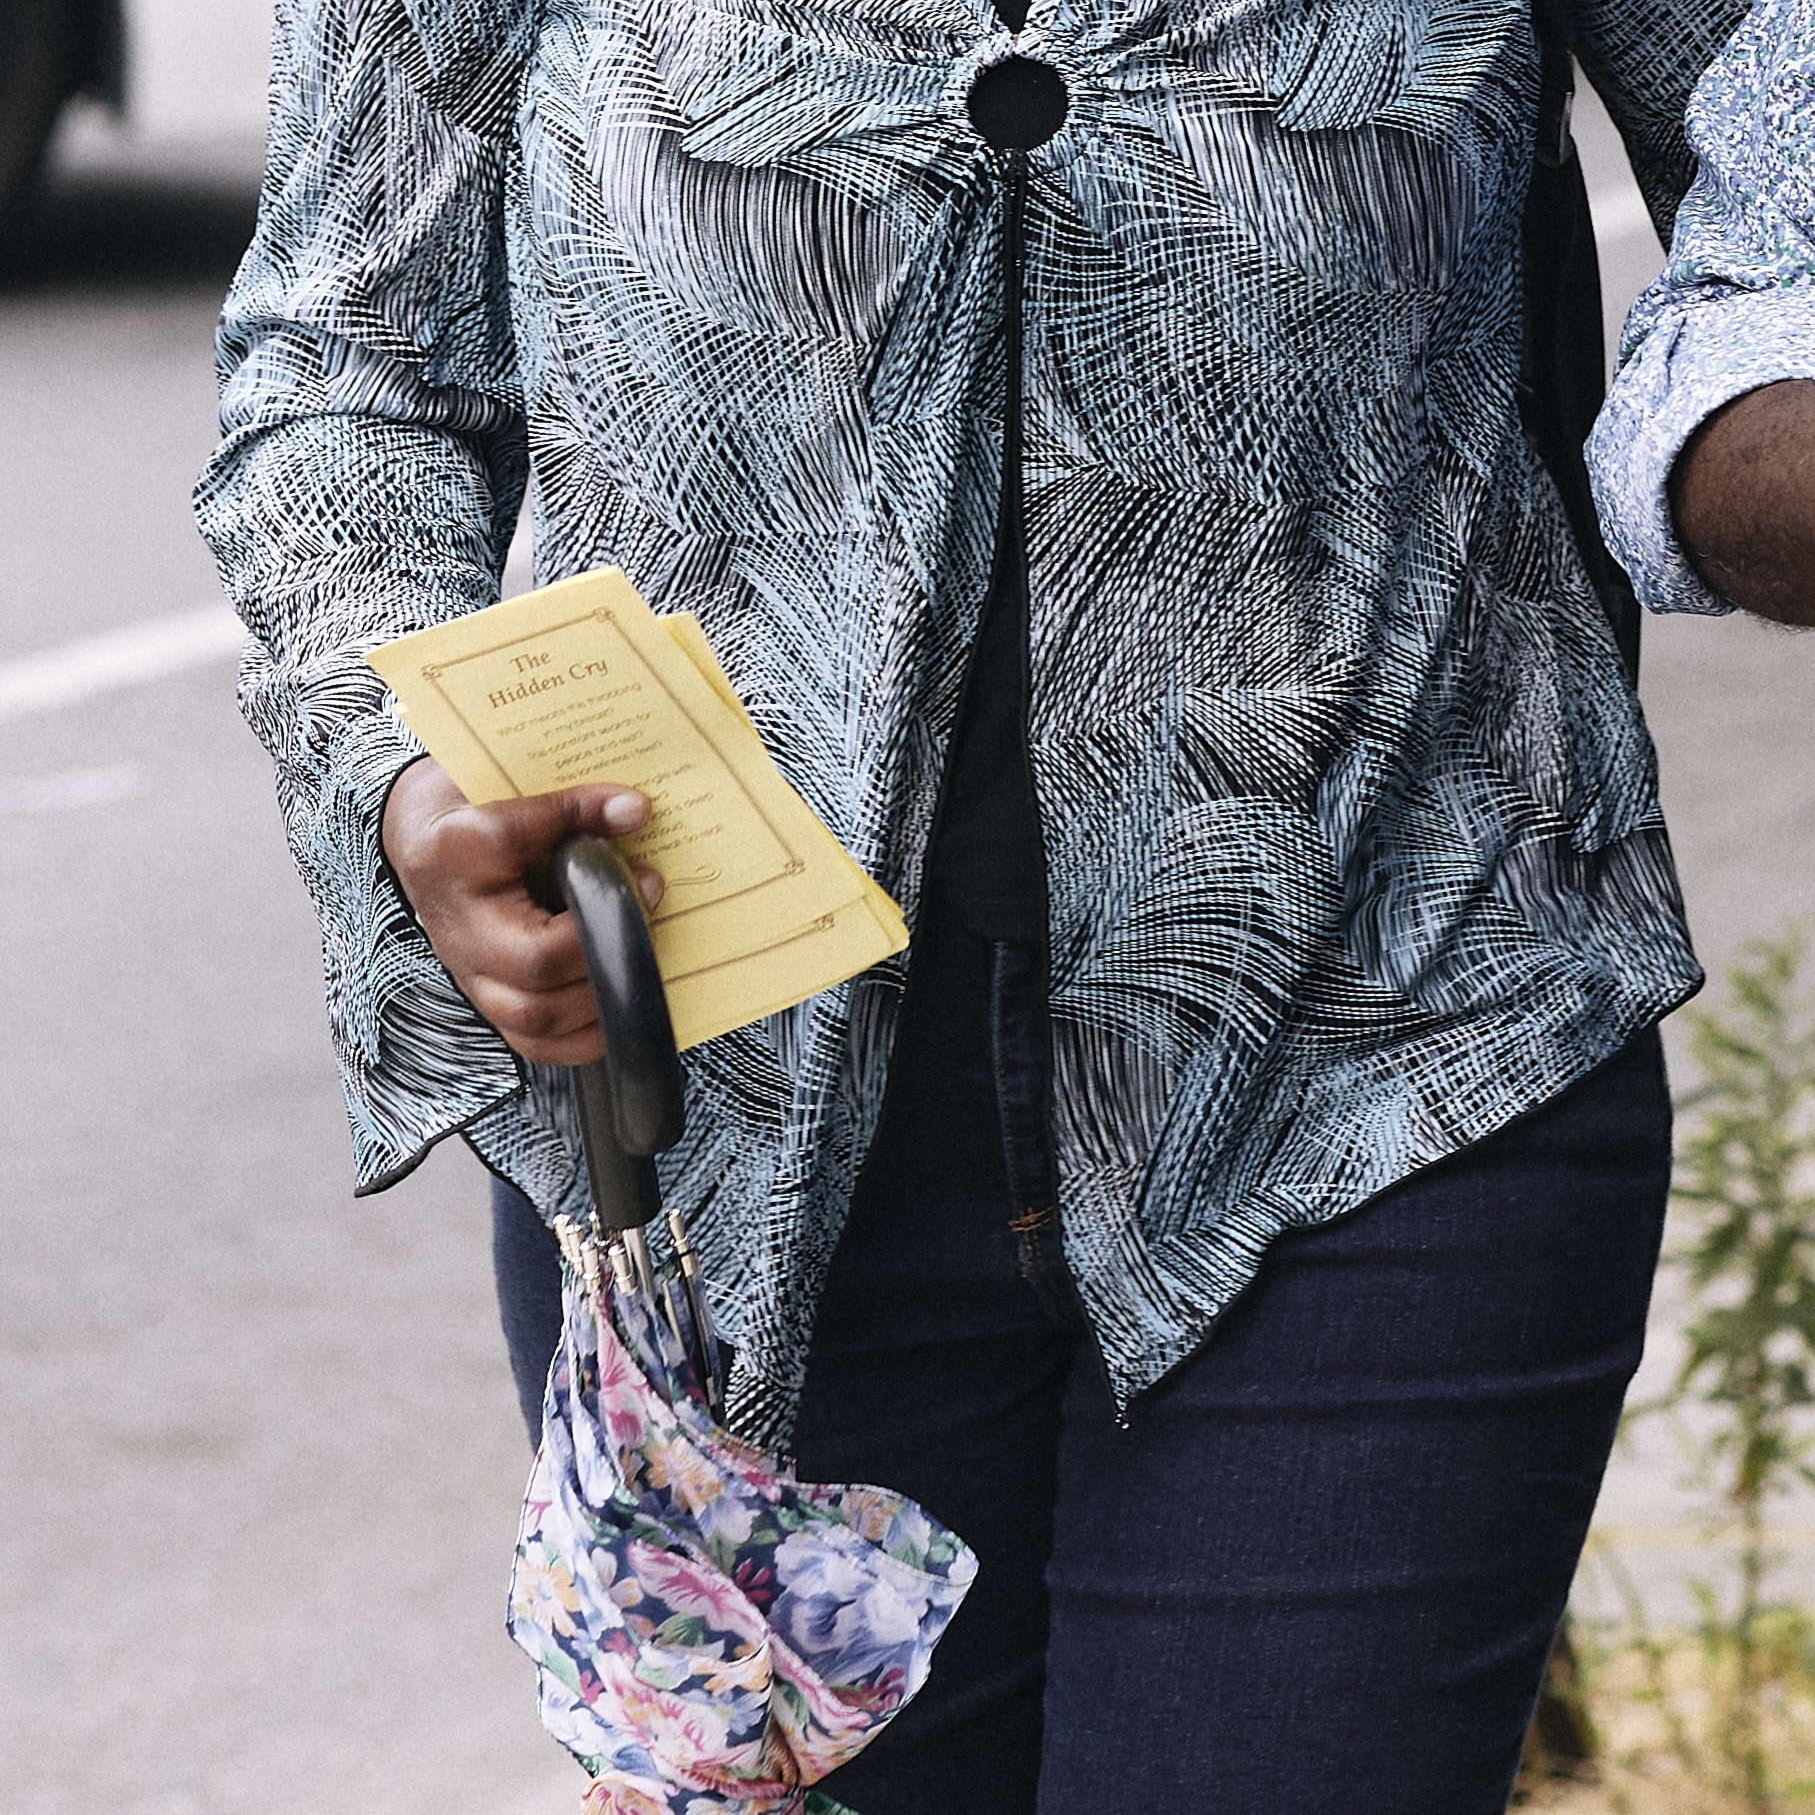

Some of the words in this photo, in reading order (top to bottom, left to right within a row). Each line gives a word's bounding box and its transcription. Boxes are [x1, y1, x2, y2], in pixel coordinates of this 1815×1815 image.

[508, 651, 552, 673] The
[487, 673, 566, 709] Hidden
[568, 659, 609, 681] Cry
[554, 748, 594, 770] peace
